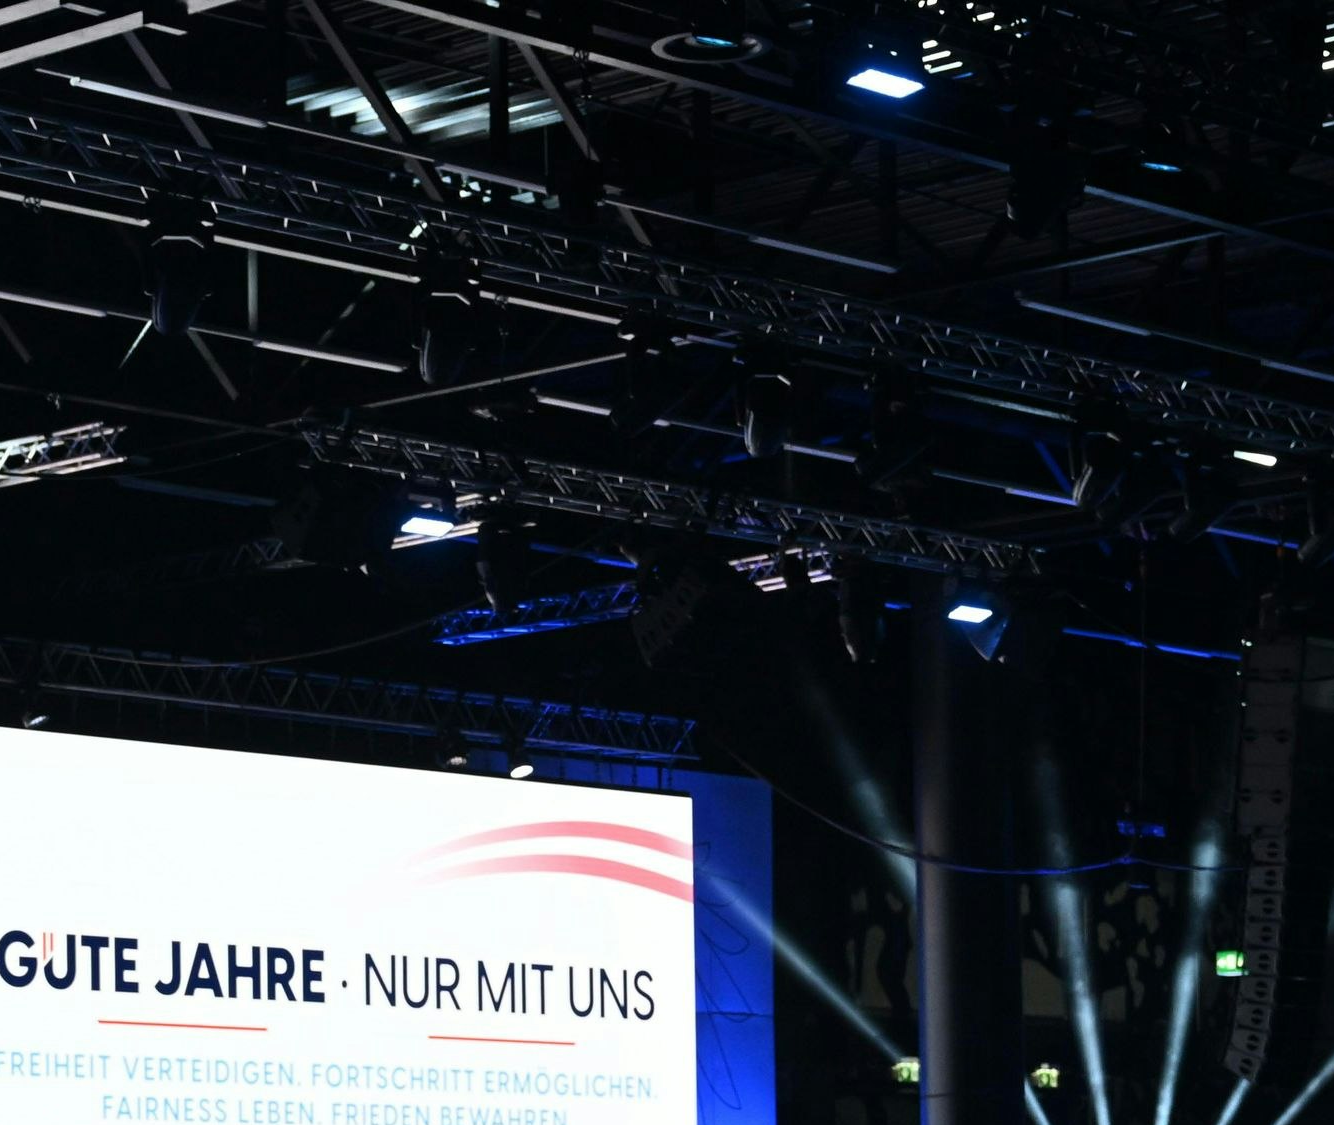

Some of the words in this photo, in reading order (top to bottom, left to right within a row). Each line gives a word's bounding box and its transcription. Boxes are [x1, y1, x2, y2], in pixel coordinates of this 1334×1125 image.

[154, 940, 326, 1004] JAHRE
[364, 952, 461, 1010] NUR
[477, 960, 554, 1013] MIT
[568, 967, 656, 1020] UNS
[123, 1055, 302, 1087] VERTEIDIGEN.
[311, 1063, 475, 1092] FORTSCHRITT
[483, 1068, 658, 1099] ERMÖGLICHEN.
[102, 1095, 228, 1123] FAIRNESS
[238, 1100, 323, 1125] LEBEN.
